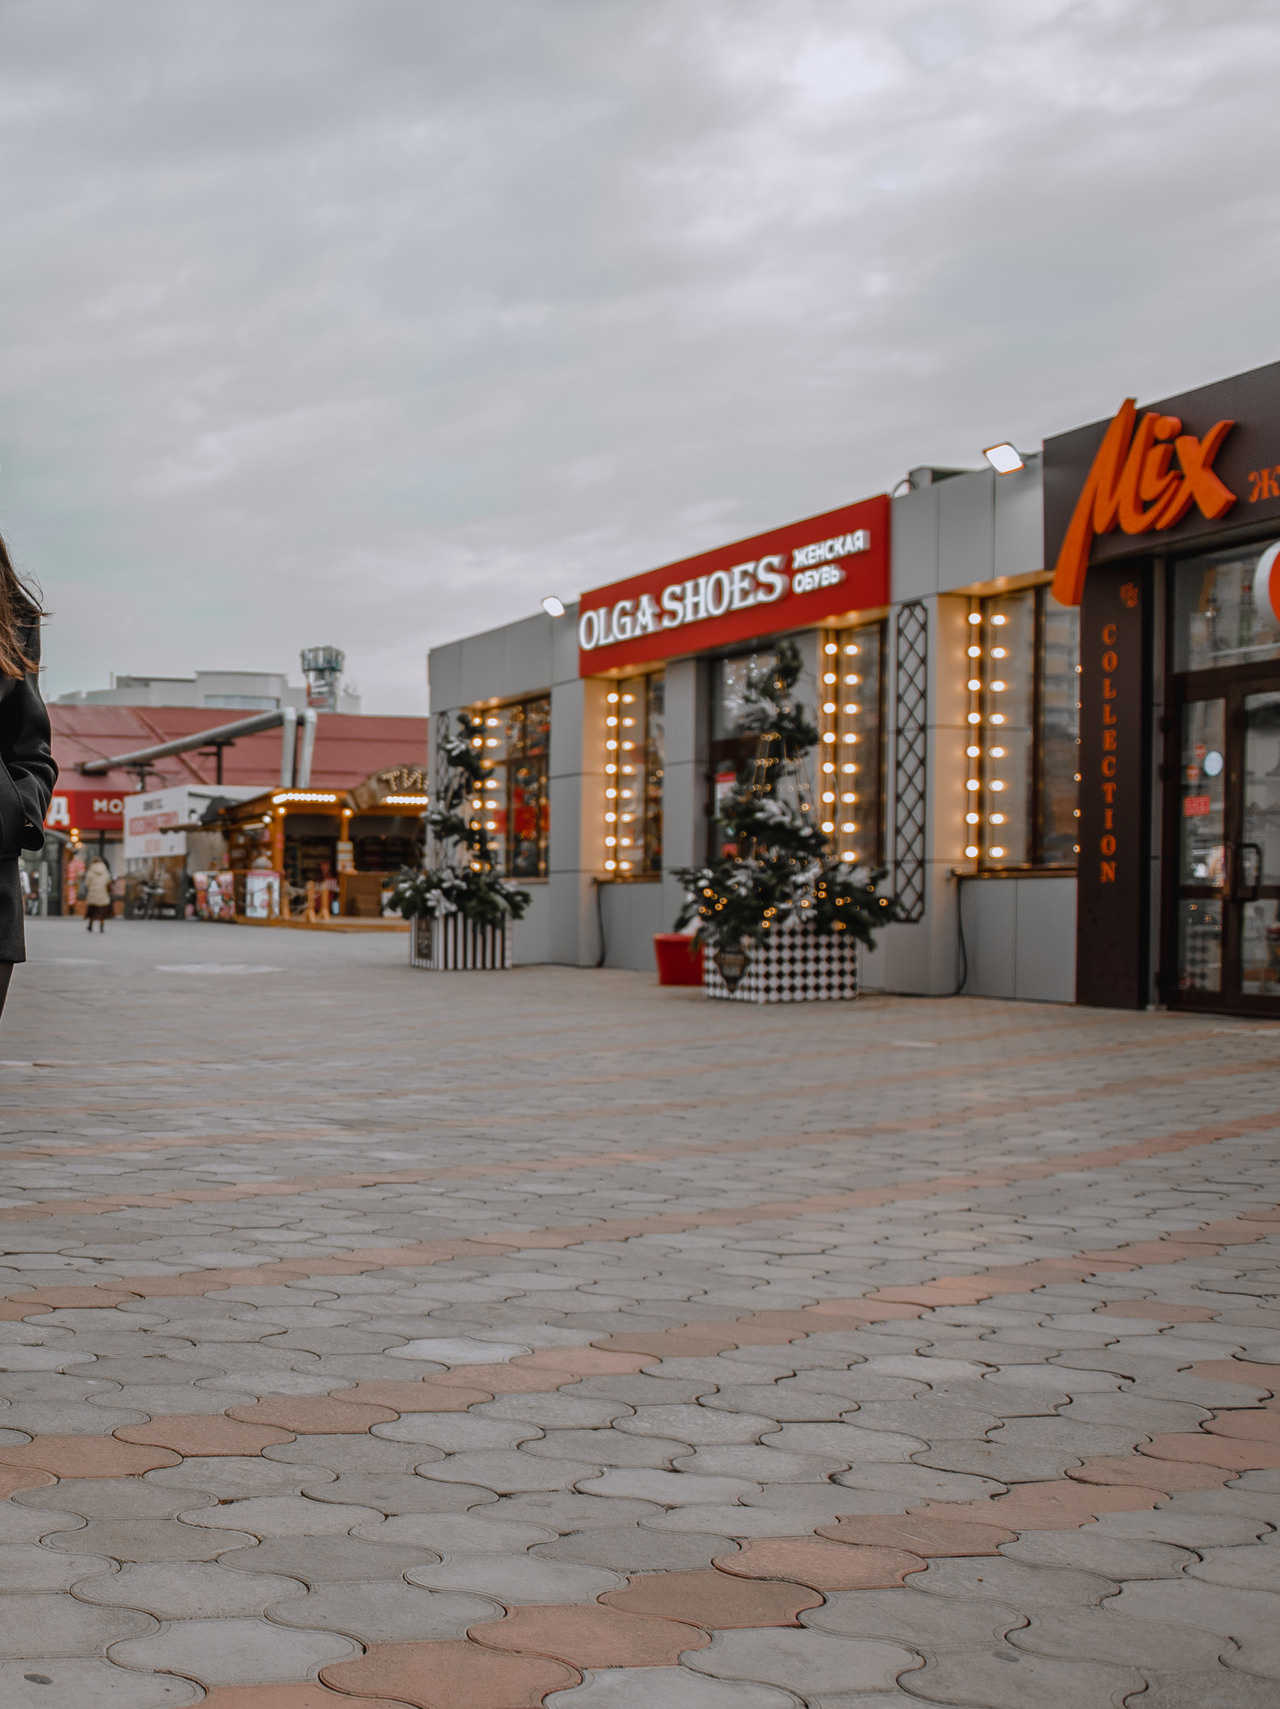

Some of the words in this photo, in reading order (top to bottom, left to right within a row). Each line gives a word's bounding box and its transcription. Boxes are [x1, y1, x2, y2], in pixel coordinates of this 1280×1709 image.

[792, 529, 868, 569] ЖЕНСКАЯ
[1052, 397, 1237, 607] Mix
[578, 594, 660, 651] OLGA
[660, 555, 789, 629] SHOES
[792, 564, 845, 594] ОБУВЬ
[1099, 623, 1119, 883] COLLECTION
